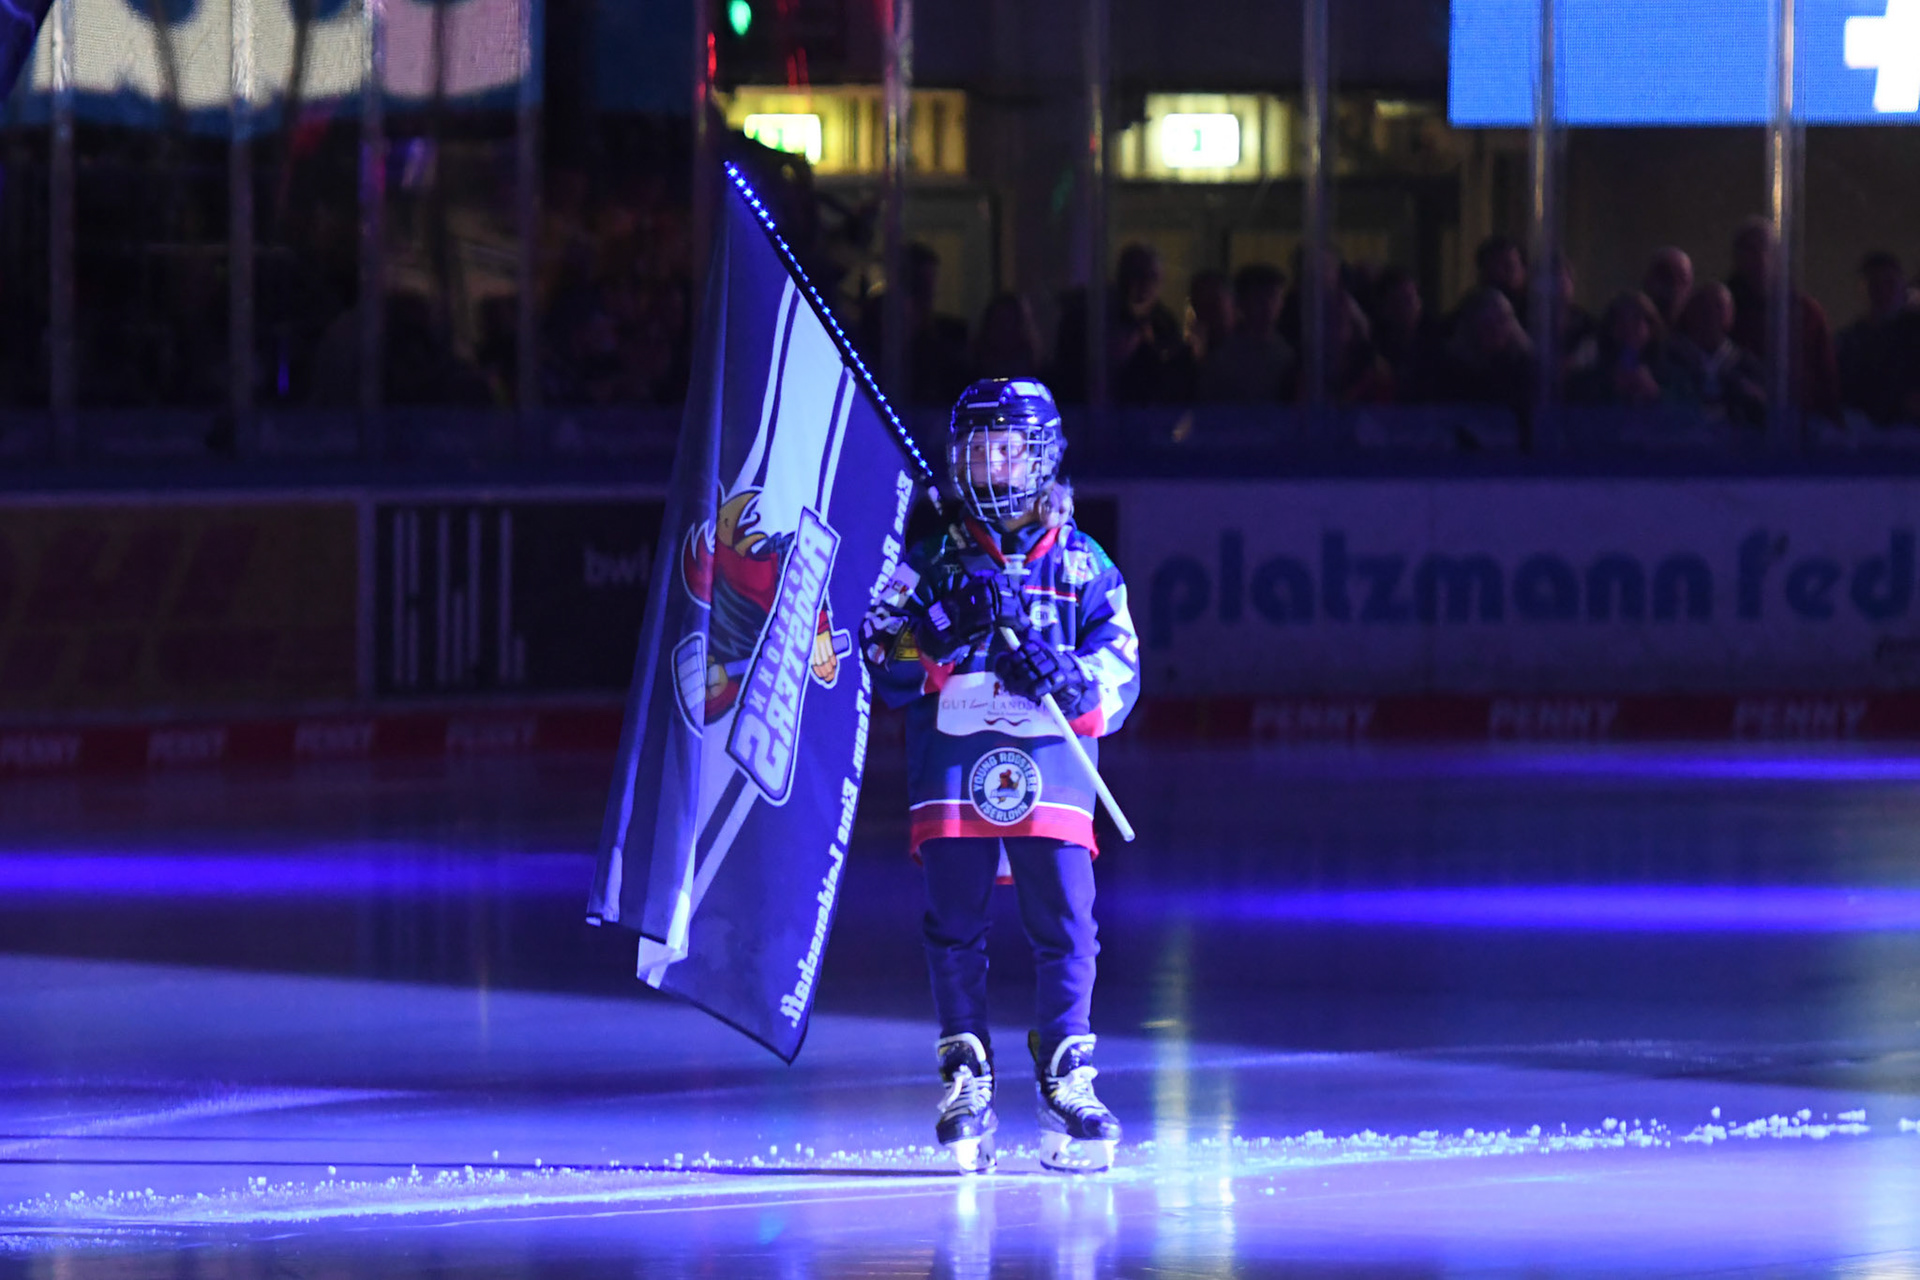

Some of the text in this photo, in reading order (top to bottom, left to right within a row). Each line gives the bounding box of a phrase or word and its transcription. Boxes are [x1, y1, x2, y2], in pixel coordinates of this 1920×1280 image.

[1151, 528, 1713, 648] platzmann
[1251, 701, 1374, 737] PENNY
[1488, 701, 1619, 737] PENNY
[1734, 701, 1867, 737] PENNY
[973, 752, 1037, 792] YOUNG ROOSTERS
[980, 801, 1029, 822] ISERLOHN
